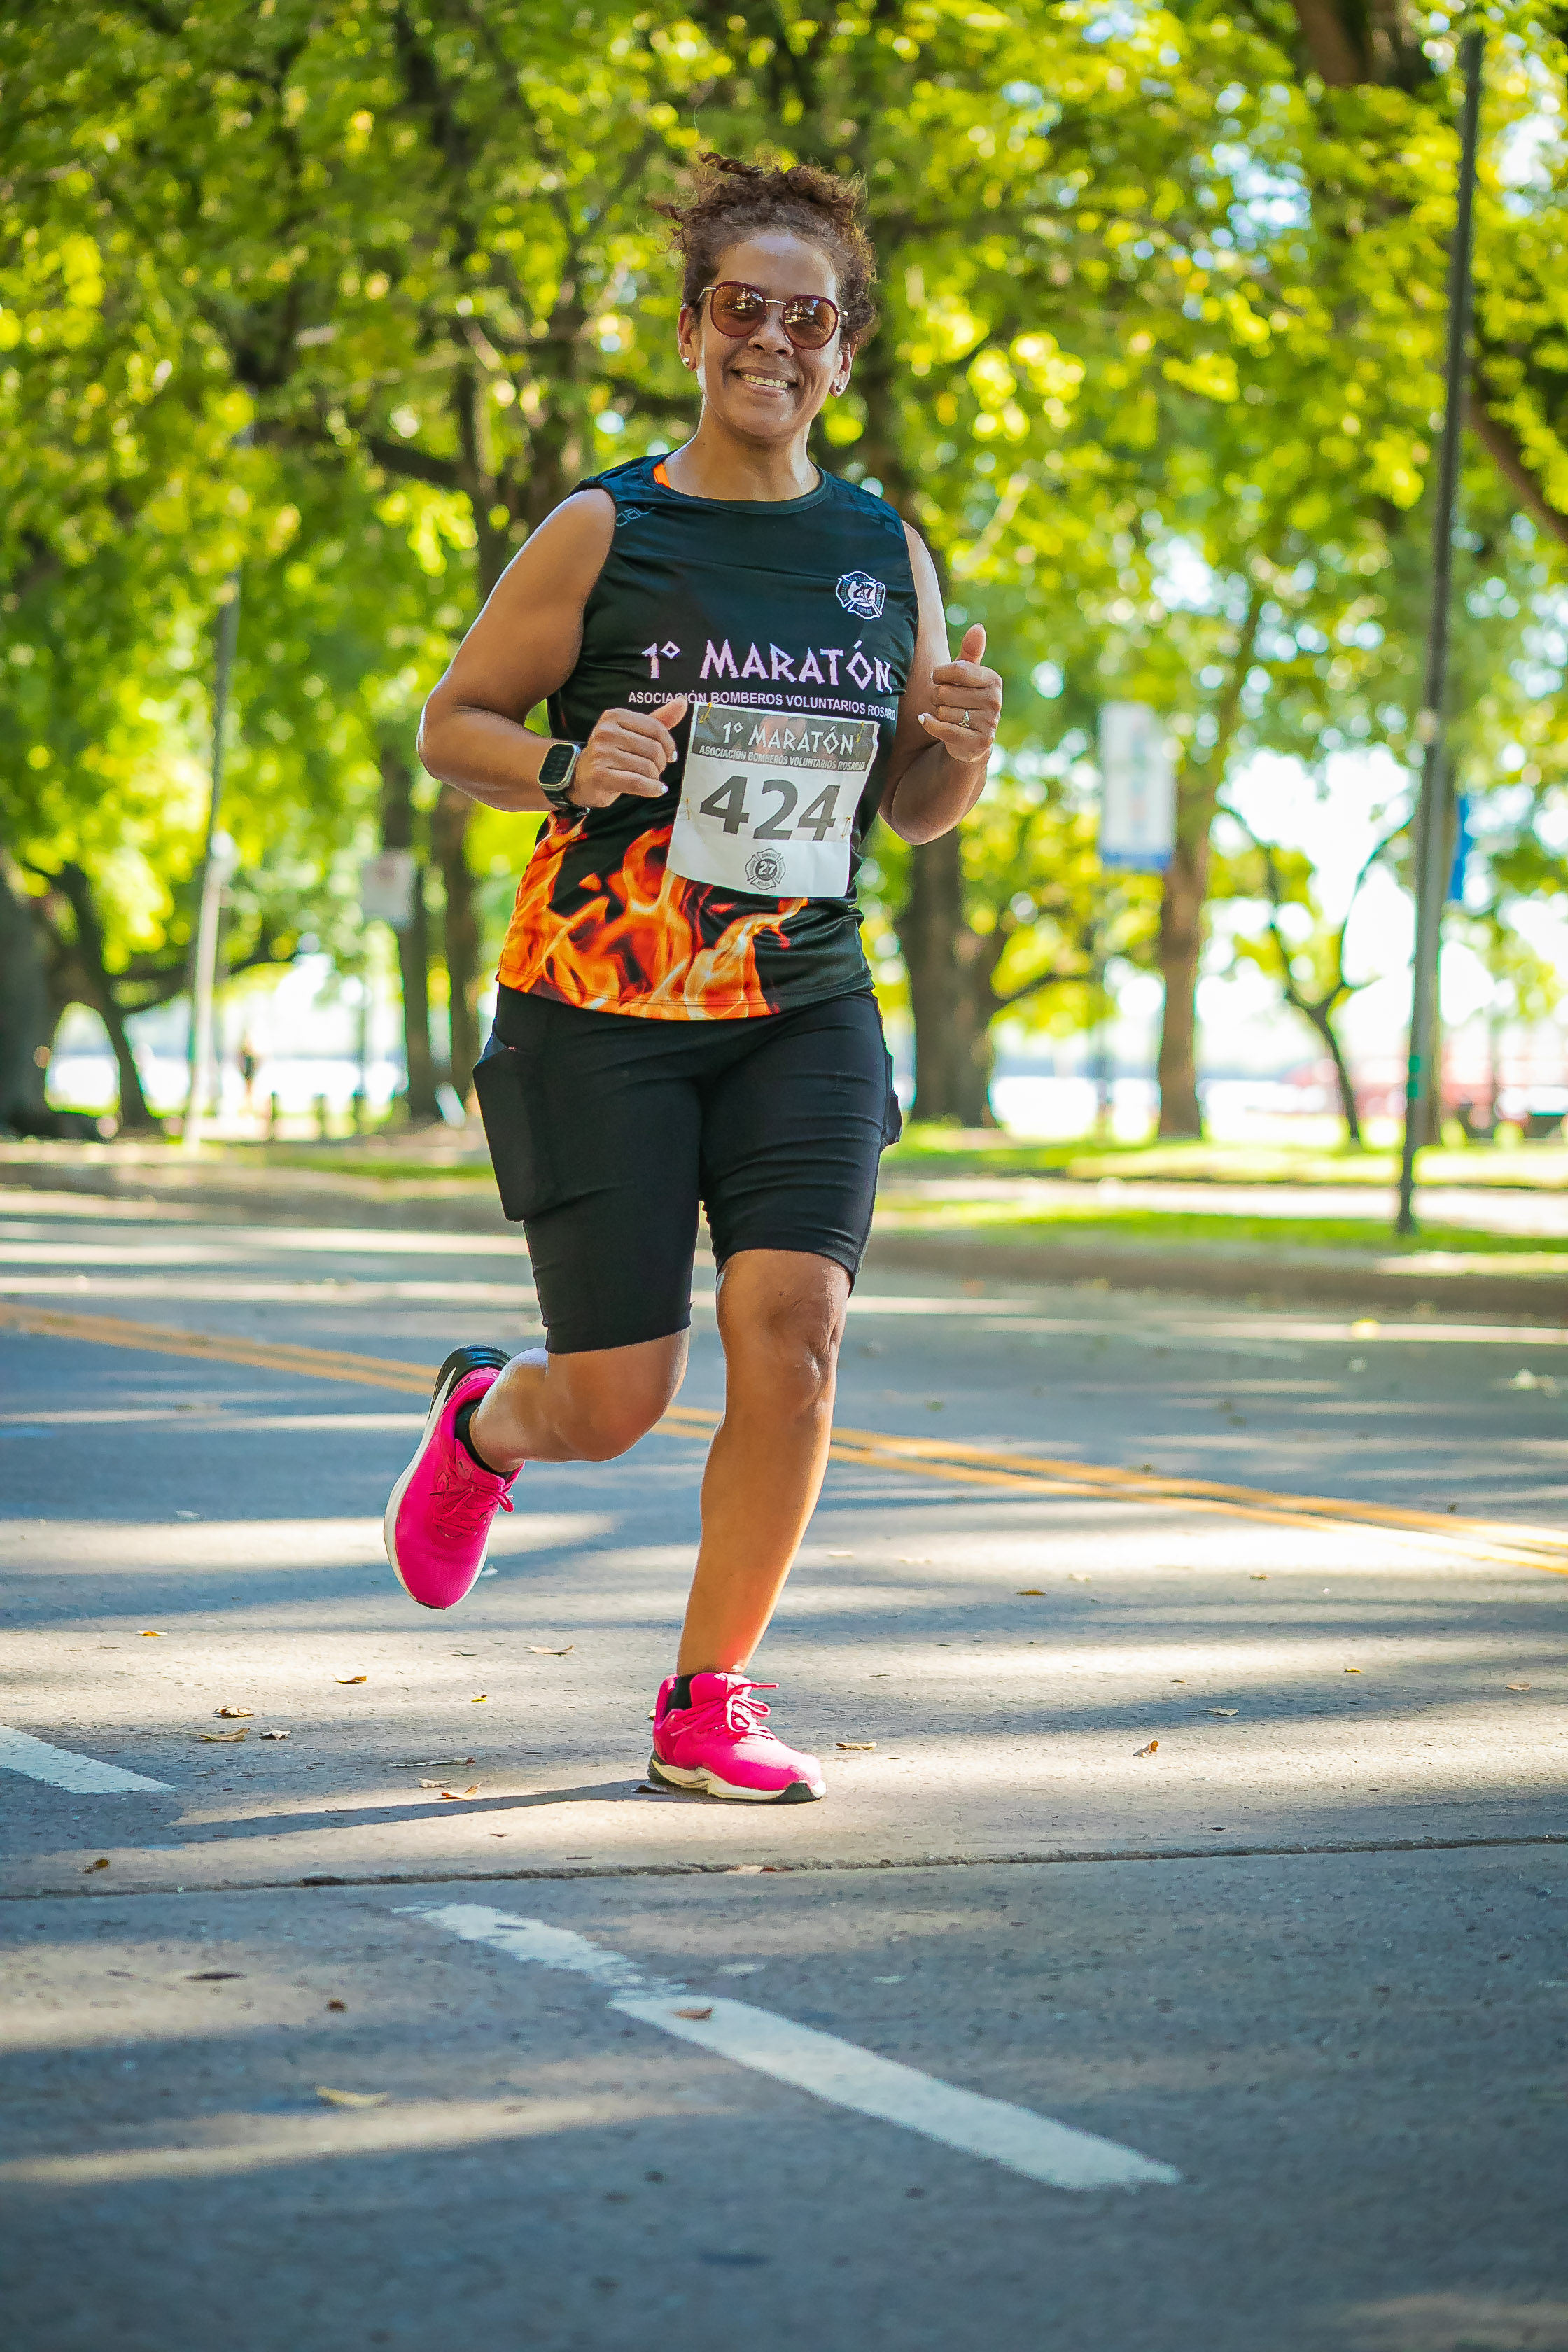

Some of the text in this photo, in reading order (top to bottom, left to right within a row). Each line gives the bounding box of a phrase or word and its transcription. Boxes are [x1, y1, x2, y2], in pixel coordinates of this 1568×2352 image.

[853, 582, 875, 599] 27
[700, 639, 892, 694] MARATÓN
[710, 692, 783, 706] BOMBEROS
[785, 694, 866, 715] VOLUNTARIOS
[867, 704, 896, 721] ROSARIO
[747, 724, 854, 756] MARATÓN
[698, 745, 865, 771] ASOCIACIÓN BOMBEROS VOLUNTARIOS ROSARIO
[699, 775, 841, 841] 424
[757, 860, 776, 876] 27
